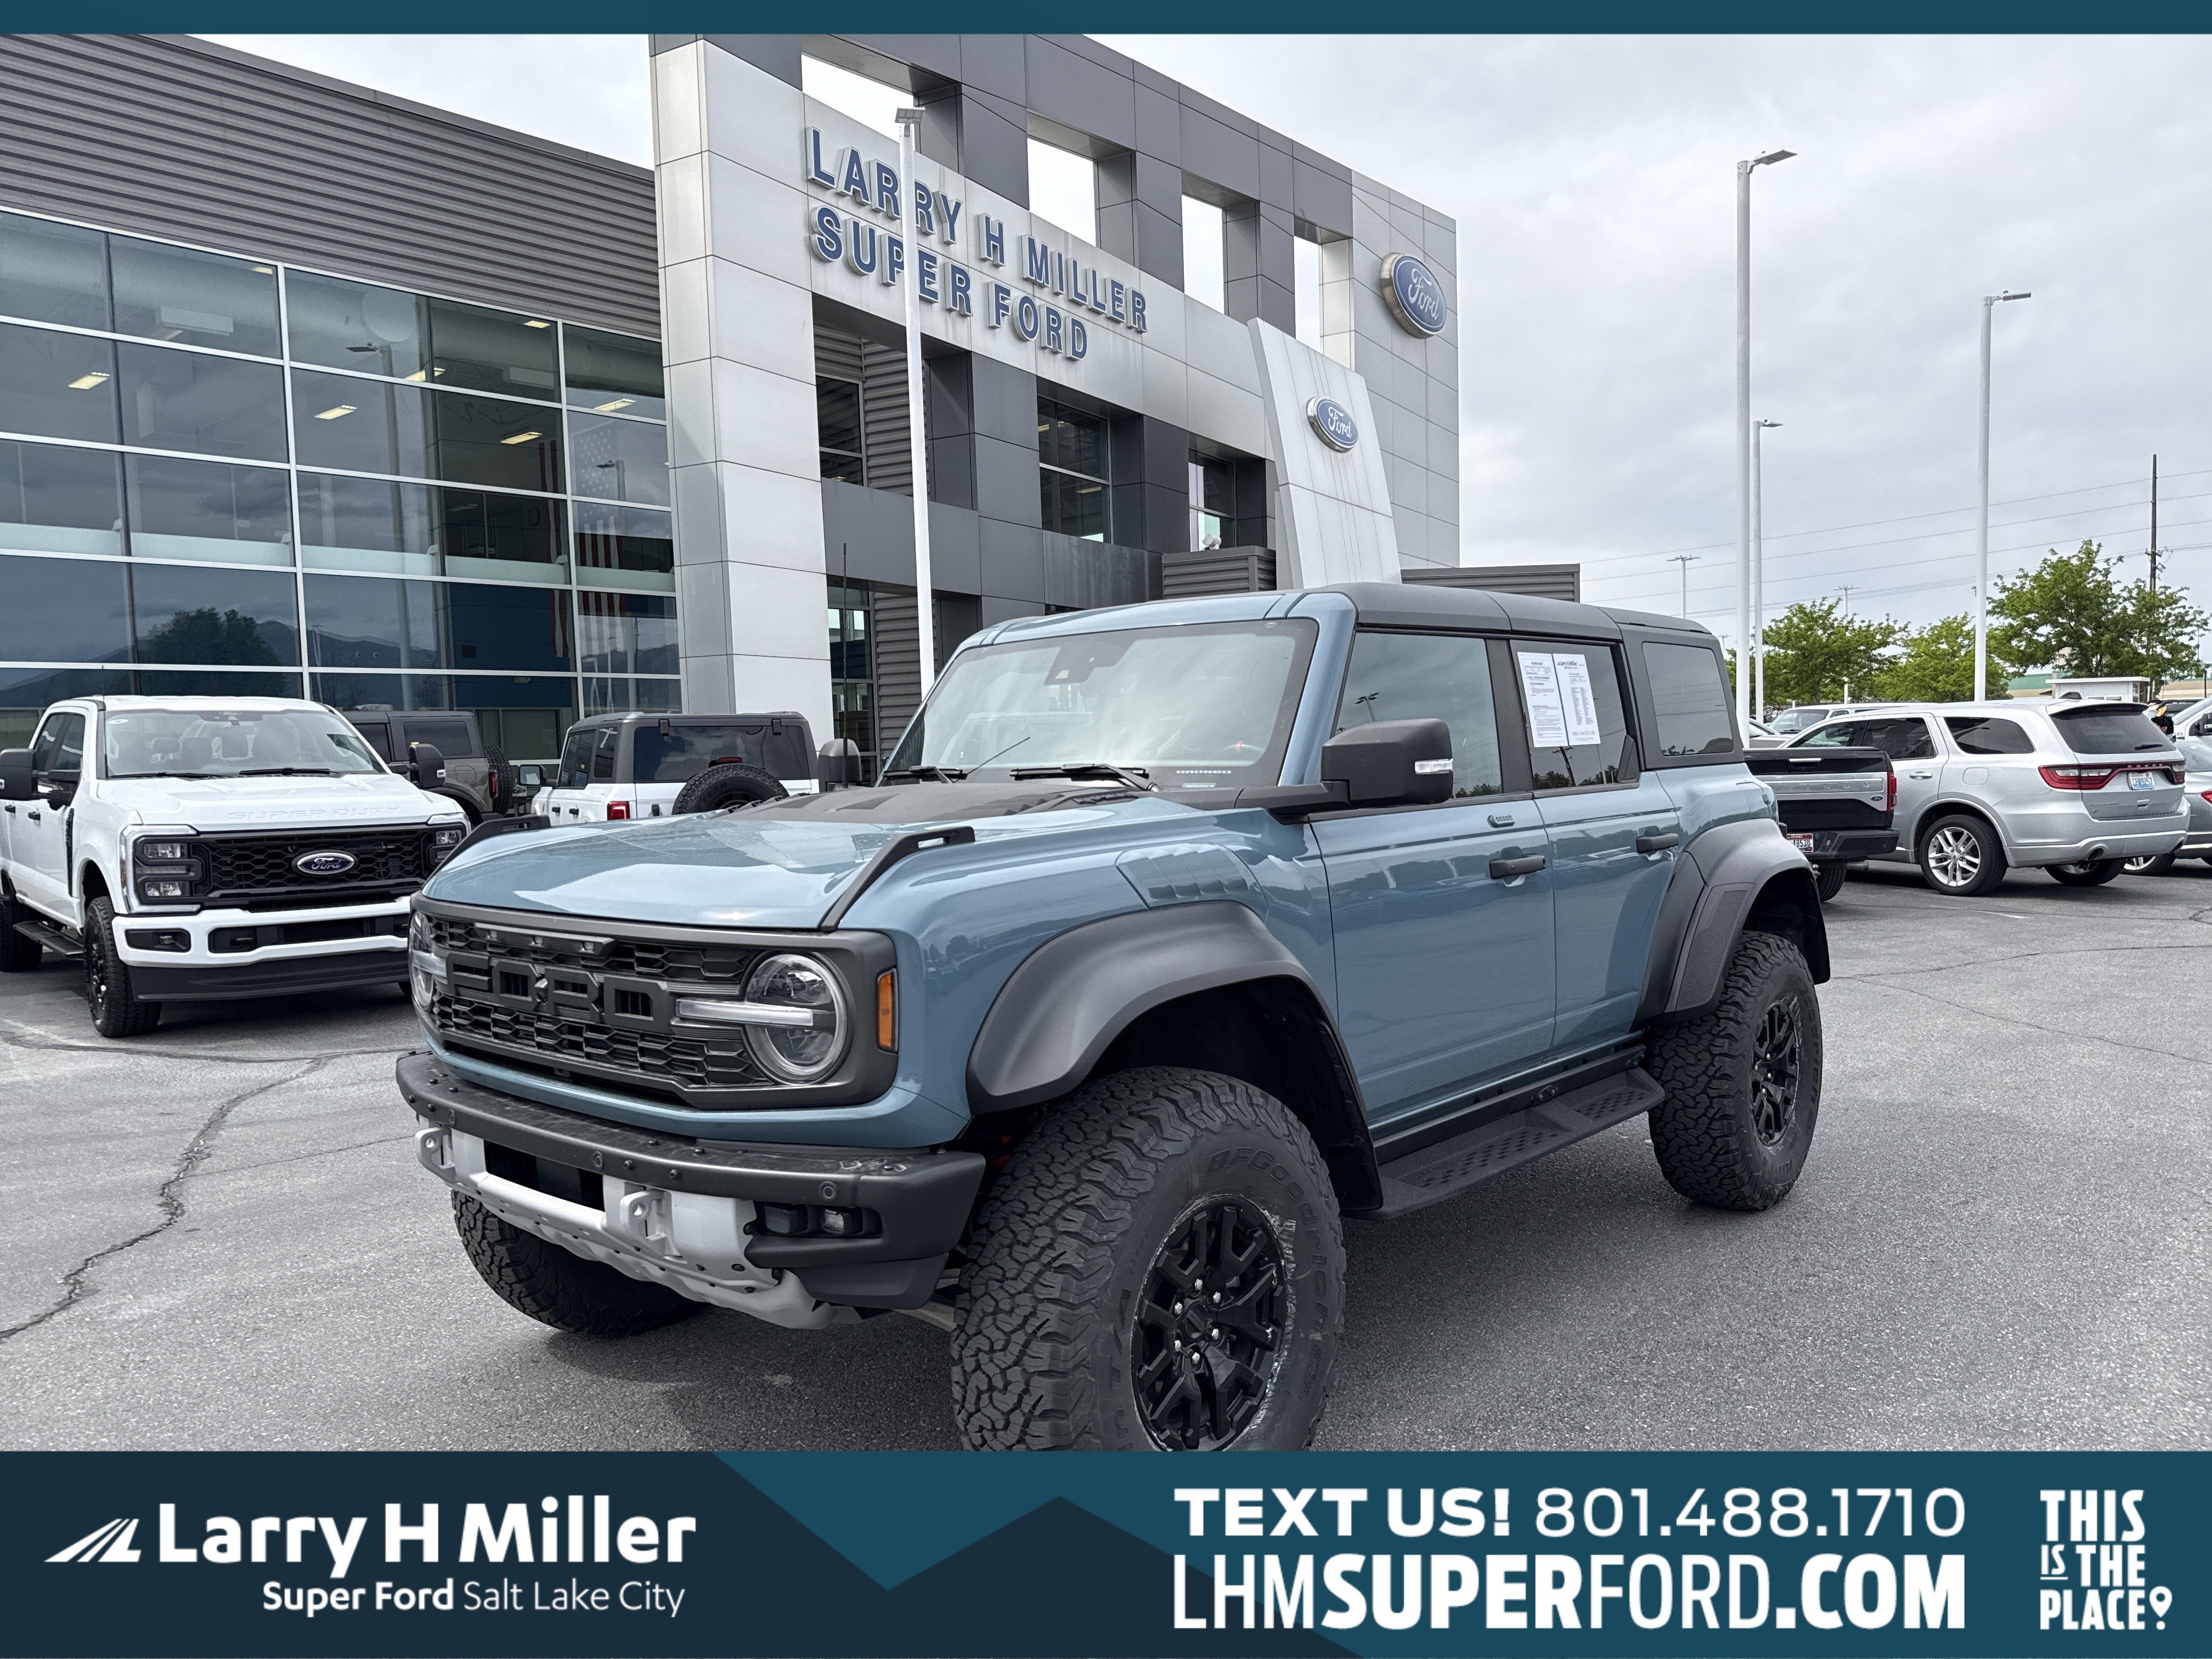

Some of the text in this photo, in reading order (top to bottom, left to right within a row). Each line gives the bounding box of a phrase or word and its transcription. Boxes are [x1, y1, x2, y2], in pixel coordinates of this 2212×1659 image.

[805, 126, 1148, 333] LARRY H MILLER
[811, 205, 1088, 361] SUPER FORD
[1408, 268, 1441, 320] Ford
[1328, 406, 1352, 439] Ford
[228, 806, 400, 820] SUPER DUTY
[311, 857, 342, 871] Ford
[446, 952, 674, 1035] FORD
